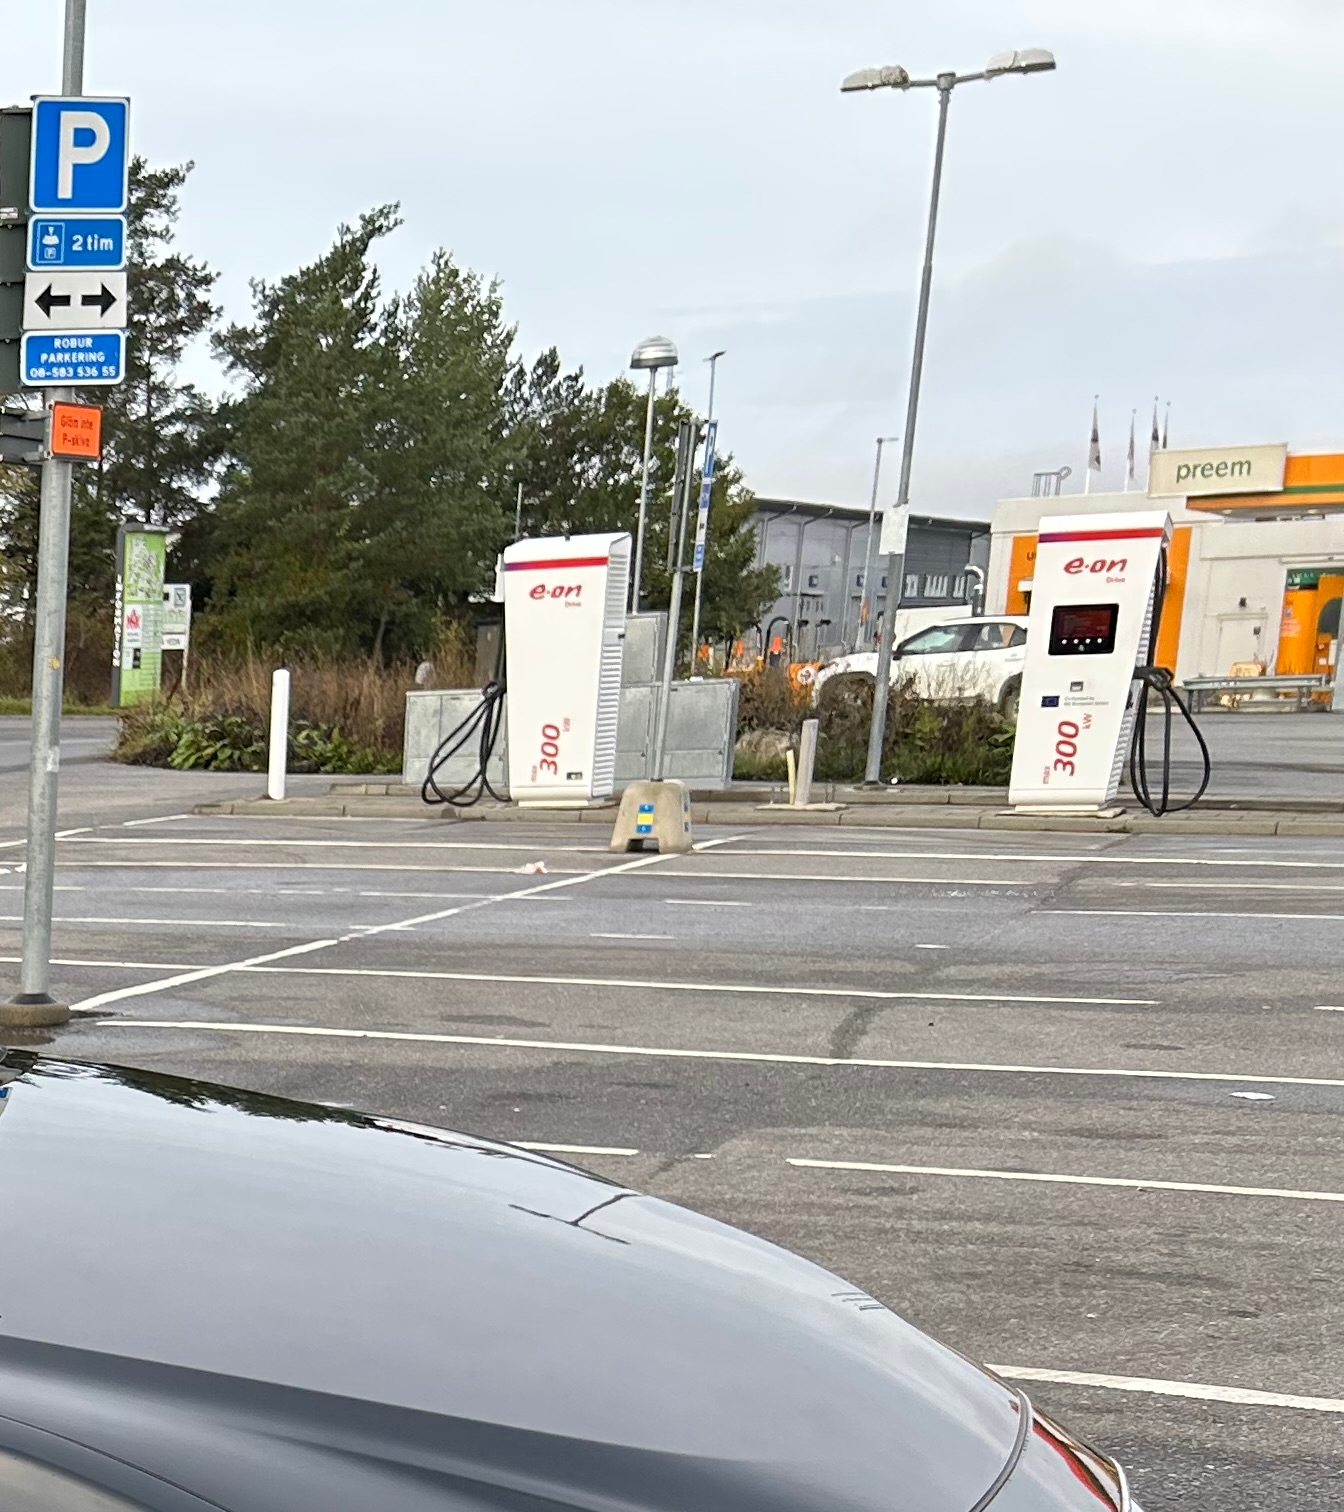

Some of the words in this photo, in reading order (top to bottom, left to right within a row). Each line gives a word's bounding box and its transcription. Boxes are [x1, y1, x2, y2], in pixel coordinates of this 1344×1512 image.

[57, 110, 111, 200] P
[72, 234, 83, 251] 2
[86, 233, 114, 252] tim
[53, 337, 93, 349] ROBUR
[40, 351, 105, 364] PARKERING
[101, 365, 116, 377] 55
[1176, 458, 1252, 483] preem
[539, 723, 560, 776] 300
[1053, 720, 1079, 777] 300
[1082, 712, 1093, 729] kW
